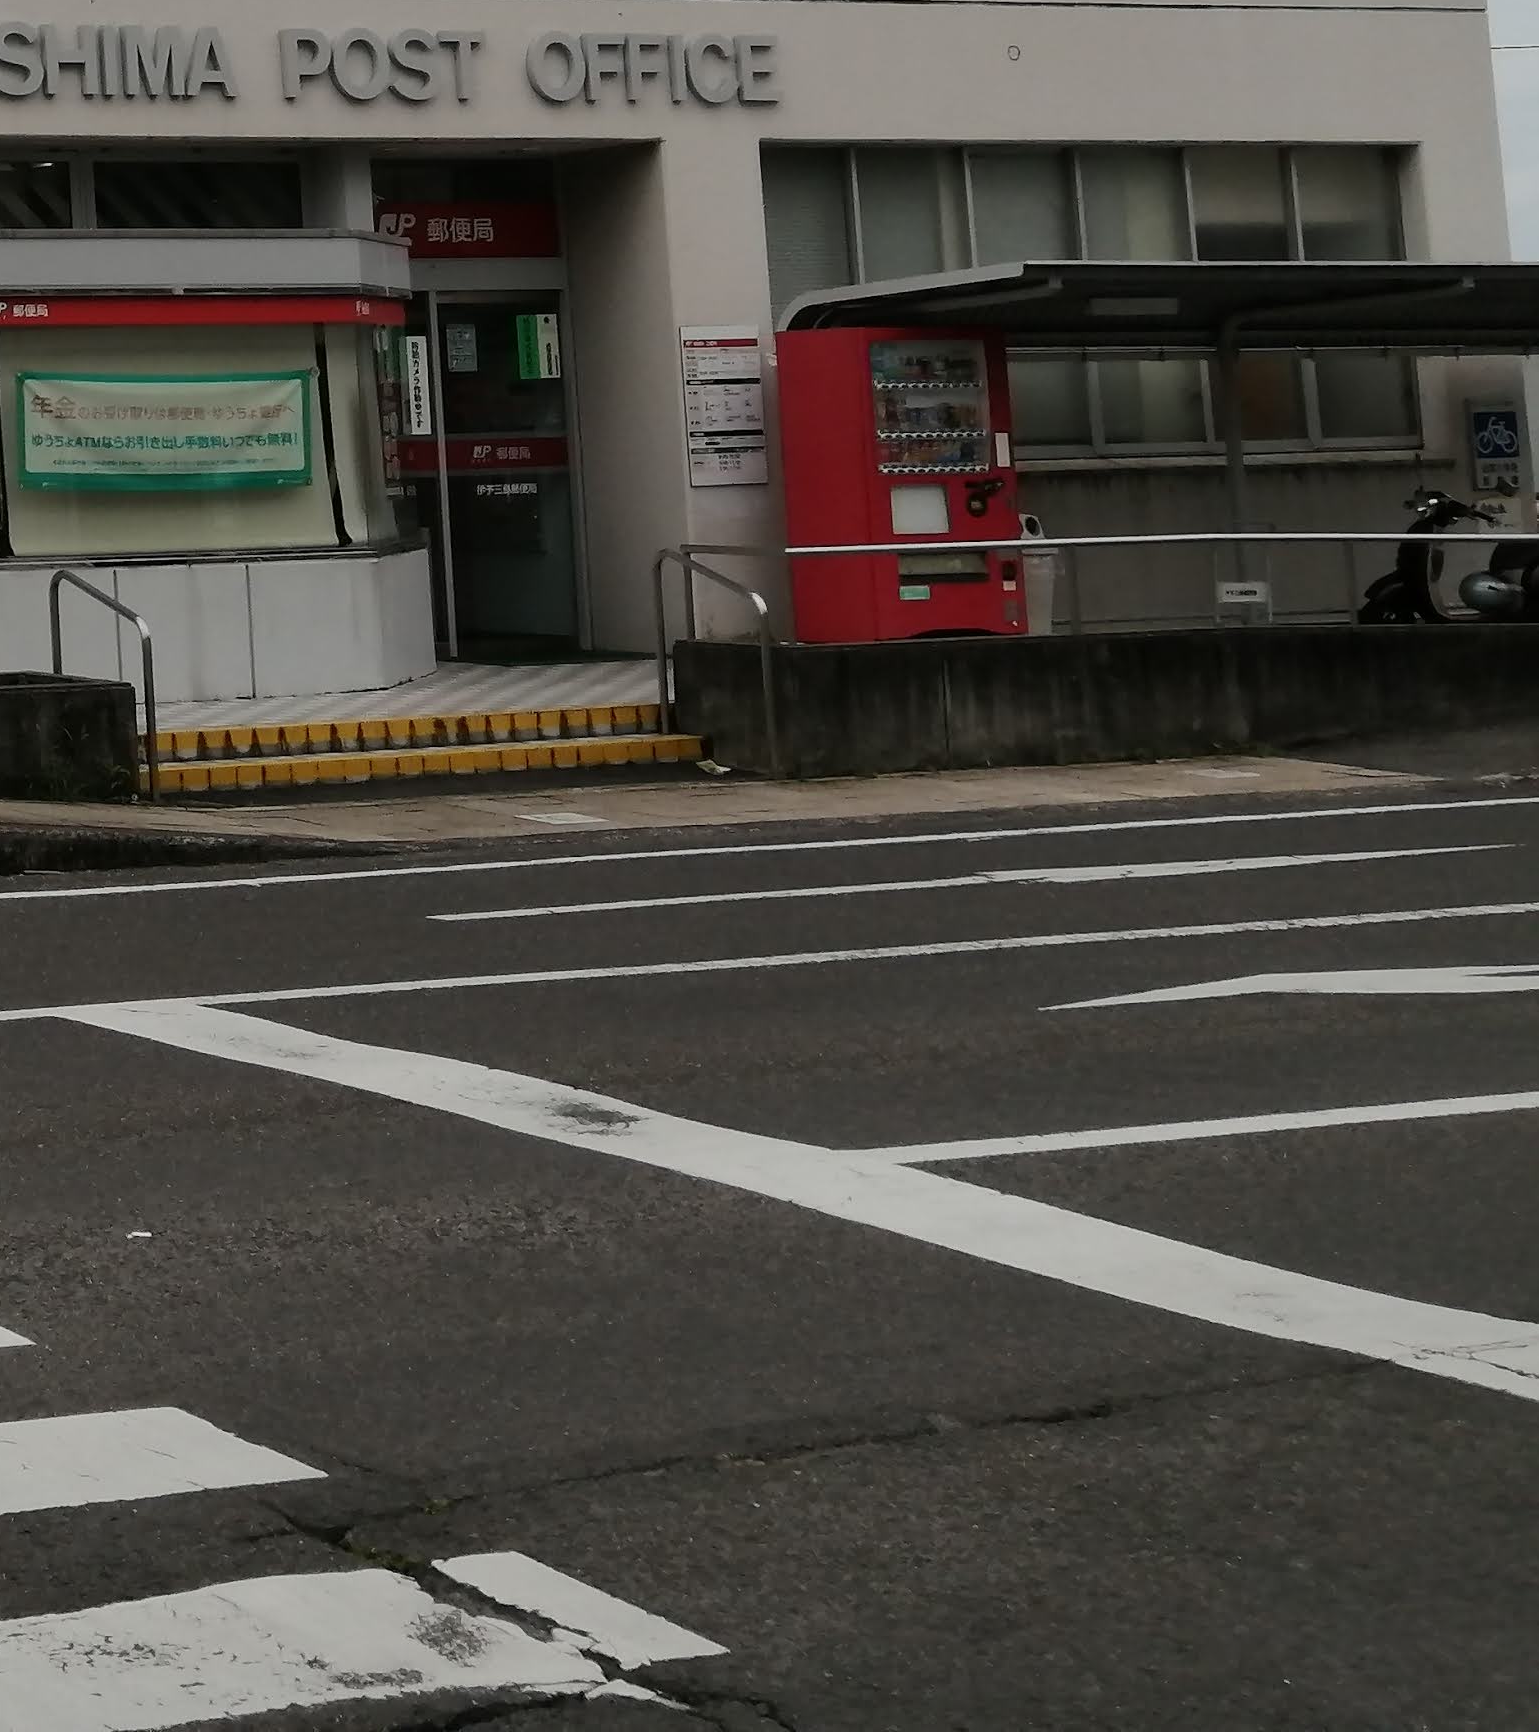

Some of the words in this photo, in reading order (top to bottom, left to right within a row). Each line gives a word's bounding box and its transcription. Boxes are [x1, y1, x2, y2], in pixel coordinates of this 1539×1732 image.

[277, 28, 485, 105] POST
[526, 31, 781, 107] OFFICE
[427, 217, 495, 243] 郵便局
